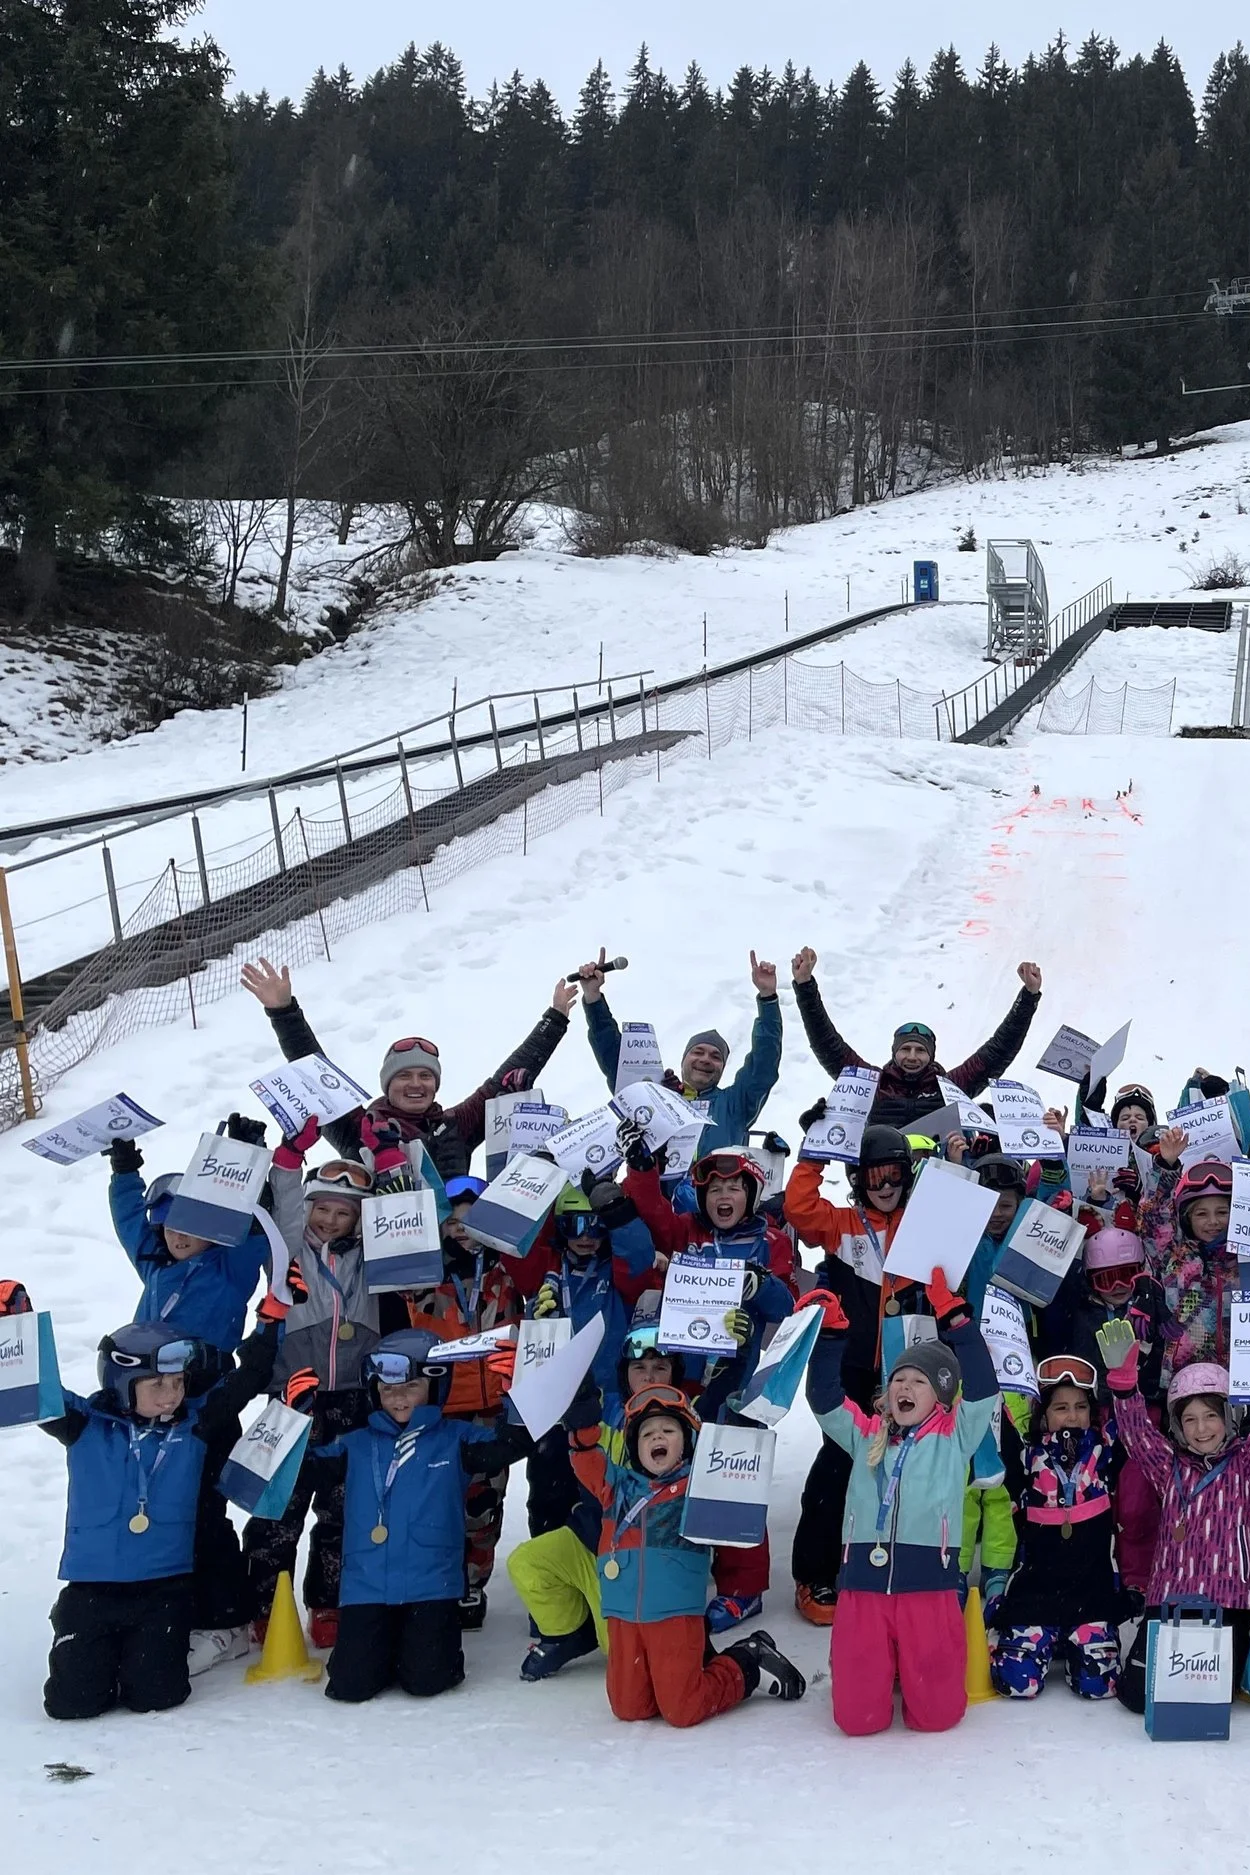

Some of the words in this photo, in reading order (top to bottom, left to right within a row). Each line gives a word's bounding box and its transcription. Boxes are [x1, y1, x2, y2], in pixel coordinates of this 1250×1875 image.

[515, 1121, 560, 1137] URKUND
[552, 1115, 605, 1145] URKUNDE
[1074, 1143, 1124, 1155] URKUNDE
[212, 1176, 246, 1192] SPORTS
[389, 1228, 424, 1239] SPORTS
[674, 1273, 736, 1287] URKUNDE
[722, 1471, 758, 1482] SPORTS
[1184, 1673, 1219, 1681] SPORTS
